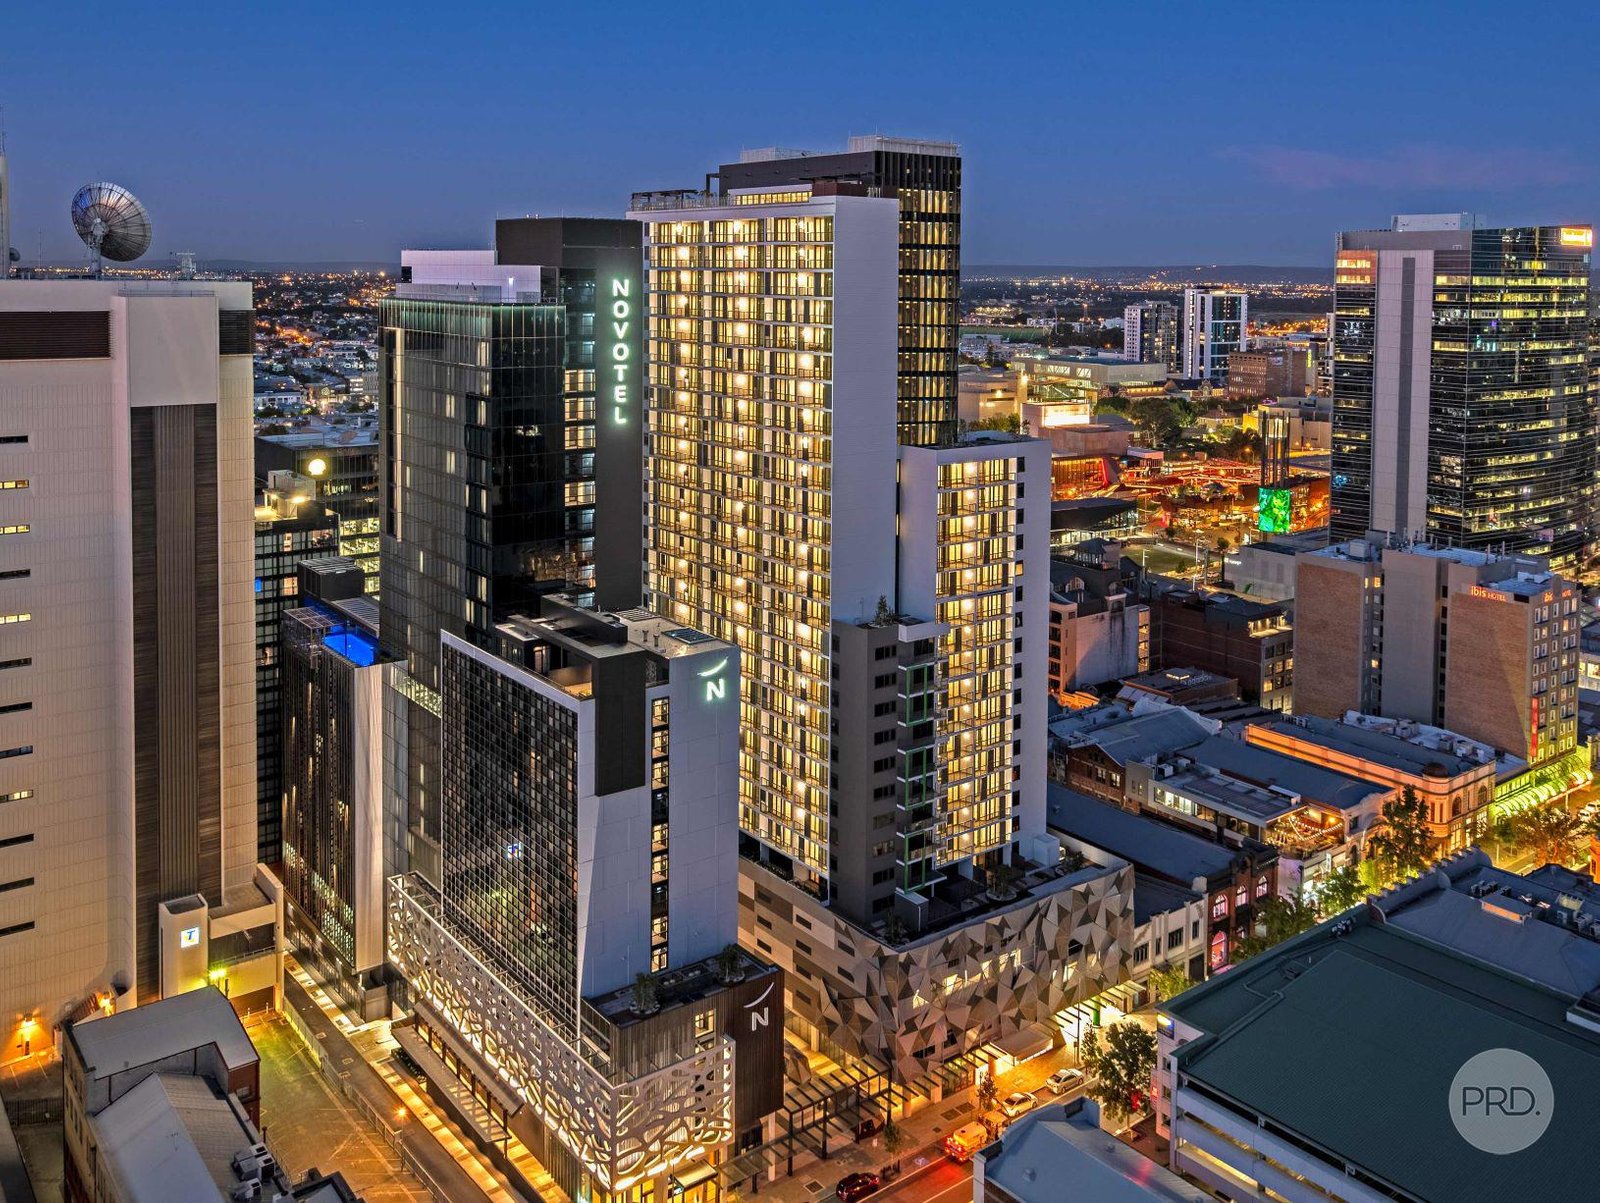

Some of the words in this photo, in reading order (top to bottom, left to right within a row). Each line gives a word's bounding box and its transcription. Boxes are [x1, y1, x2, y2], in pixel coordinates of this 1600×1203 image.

[612, 278, 630, 425] NOVOTEL
[706, 678, 726, 701] N
[751, 1006, 769, 1032] N
